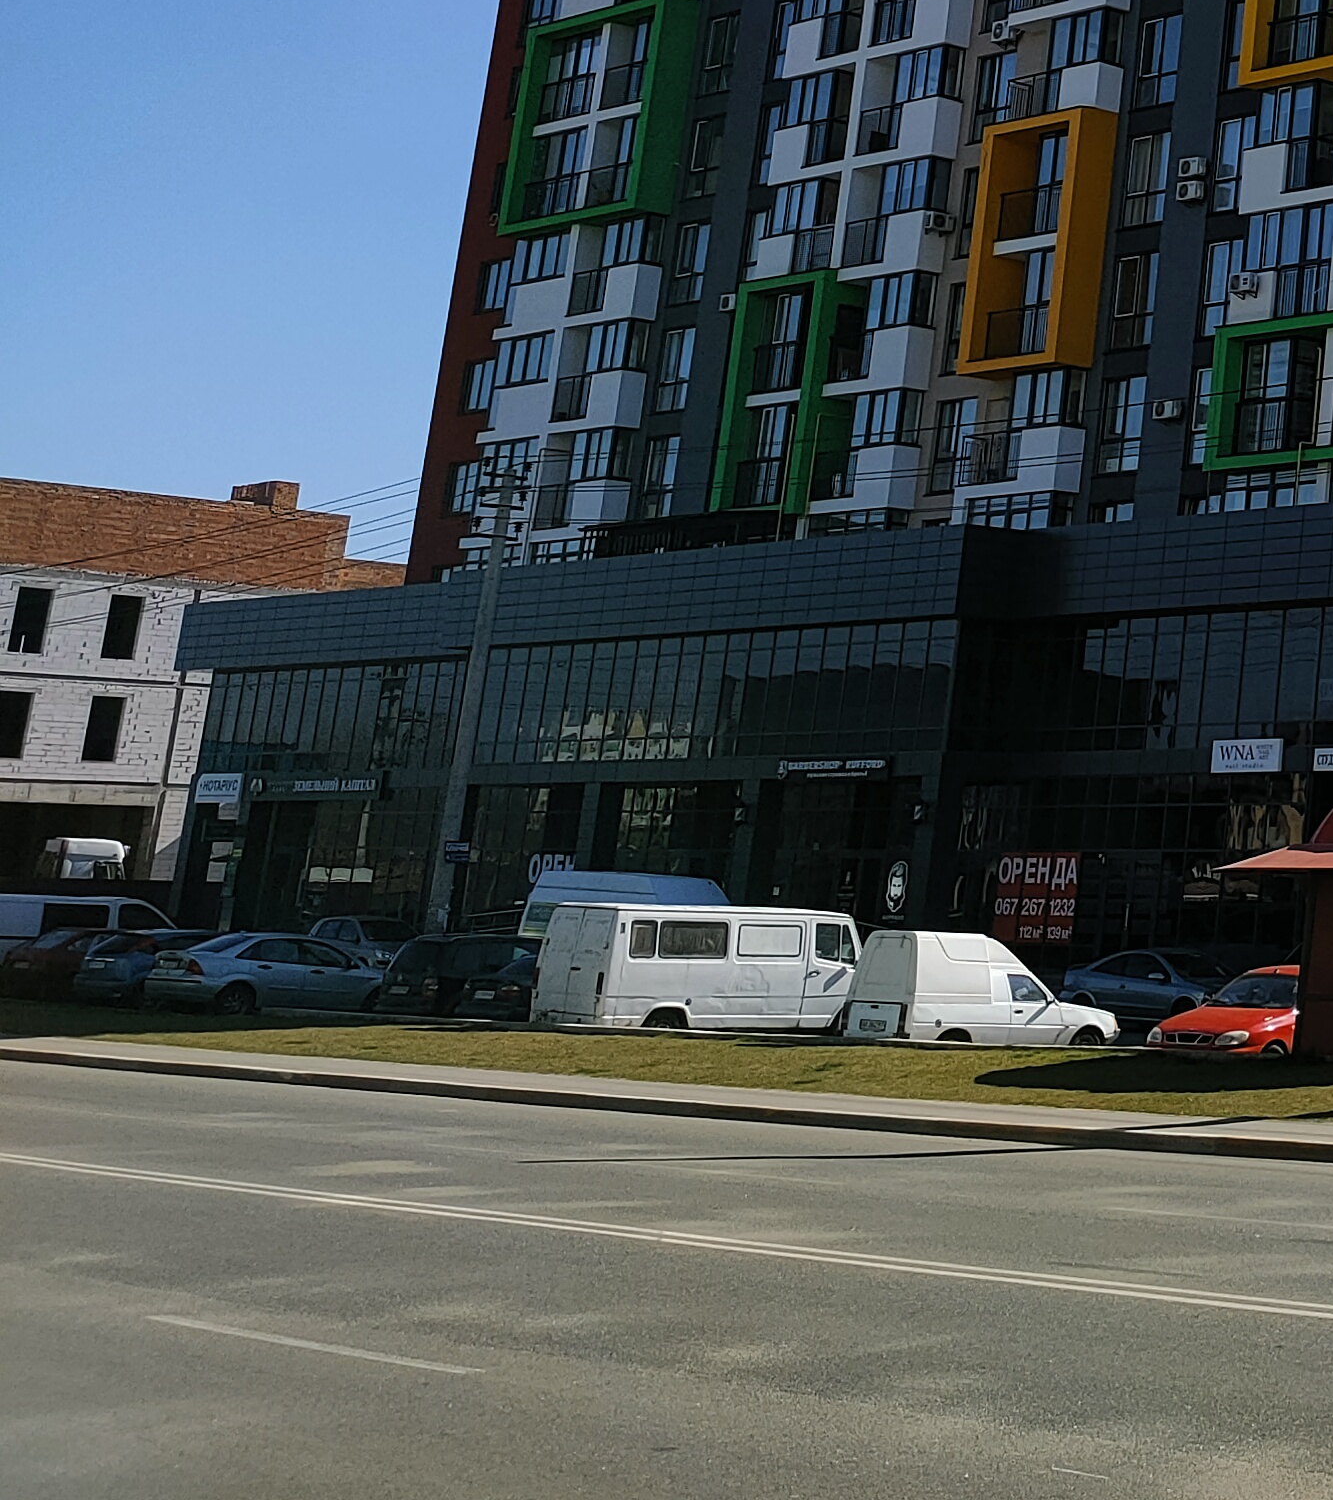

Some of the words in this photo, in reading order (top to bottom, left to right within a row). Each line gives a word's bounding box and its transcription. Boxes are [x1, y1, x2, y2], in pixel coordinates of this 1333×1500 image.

[1220, 745, 1254, 760] WNA
[202, 779, 238, 792] НОТАРІУС
[998, 857, 1078, 891] ОРЕНДА
[994, 898, 1019, 915] 067
[1020, 898, 1046, 916] 267
[1050, 898, 1075, 916] 1232
